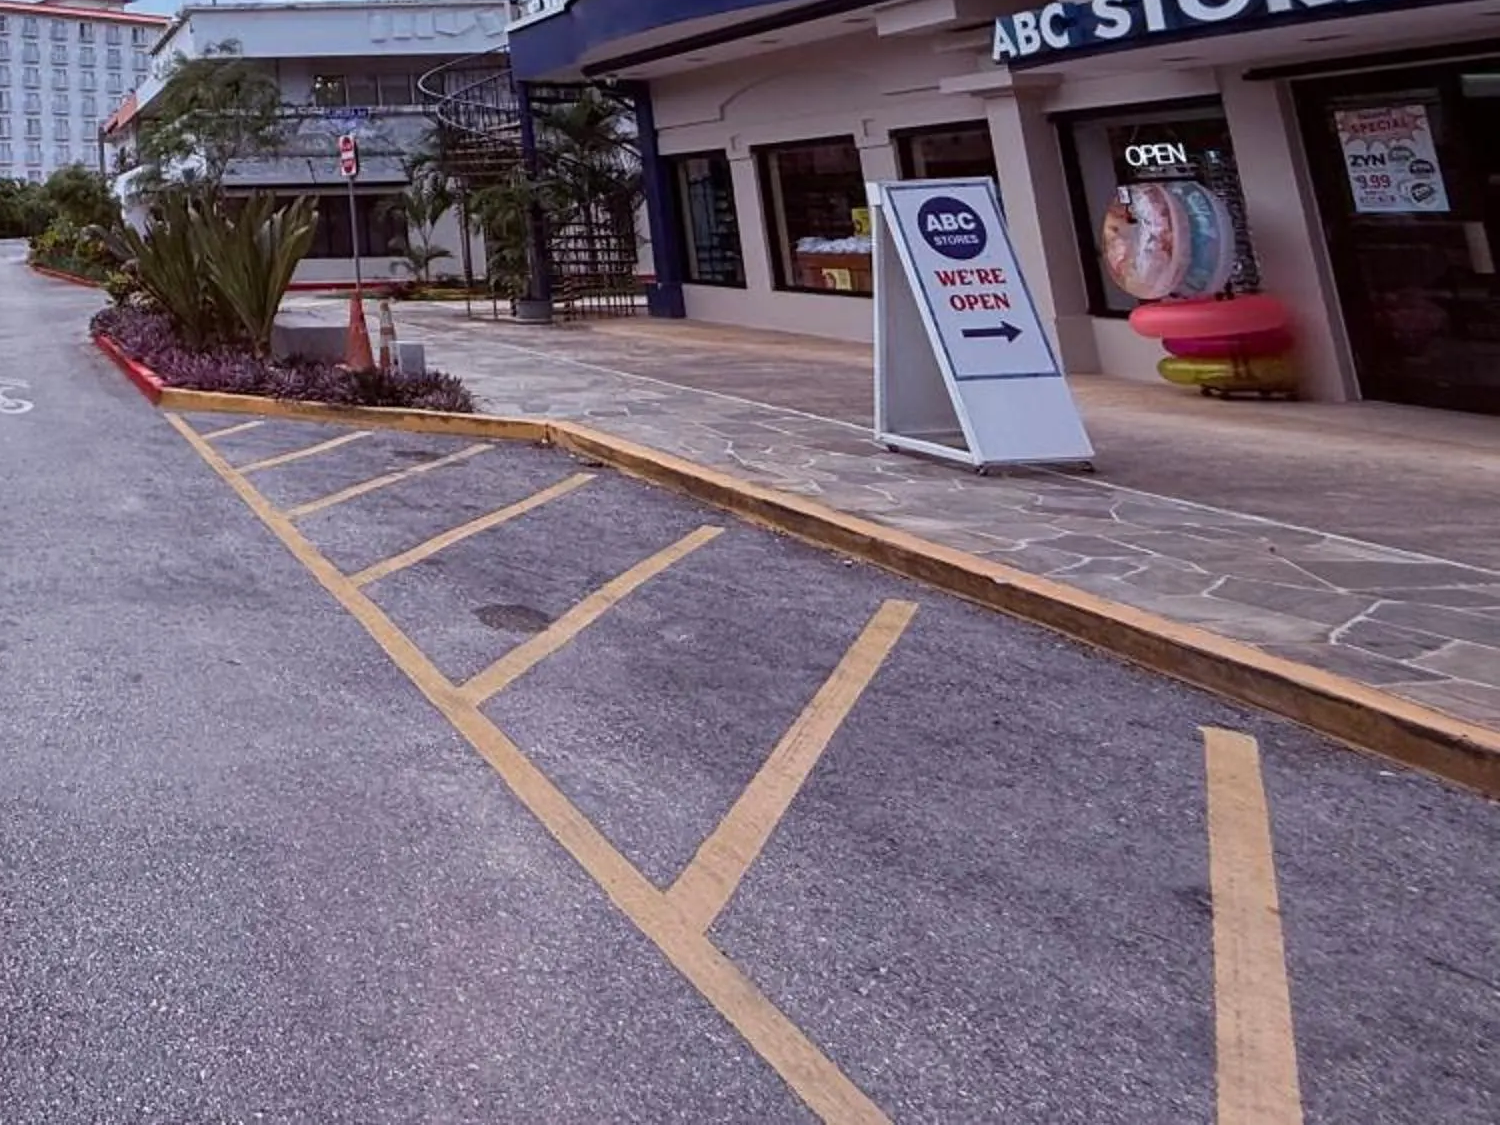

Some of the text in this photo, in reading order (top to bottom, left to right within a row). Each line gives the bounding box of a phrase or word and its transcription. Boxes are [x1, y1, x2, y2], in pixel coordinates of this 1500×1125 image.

[992, 2, 1070, 61] ABC
[1125, 143, 1187, 166] OPEN
[1348, 153, 1386, 167] ZYN
[926, 212, 976, 232] ABC
[933, 234, 980, 246] STORES
[934, 268, 1007, 287] WE'RE
[950, 293, 1011, 312] OPEN
